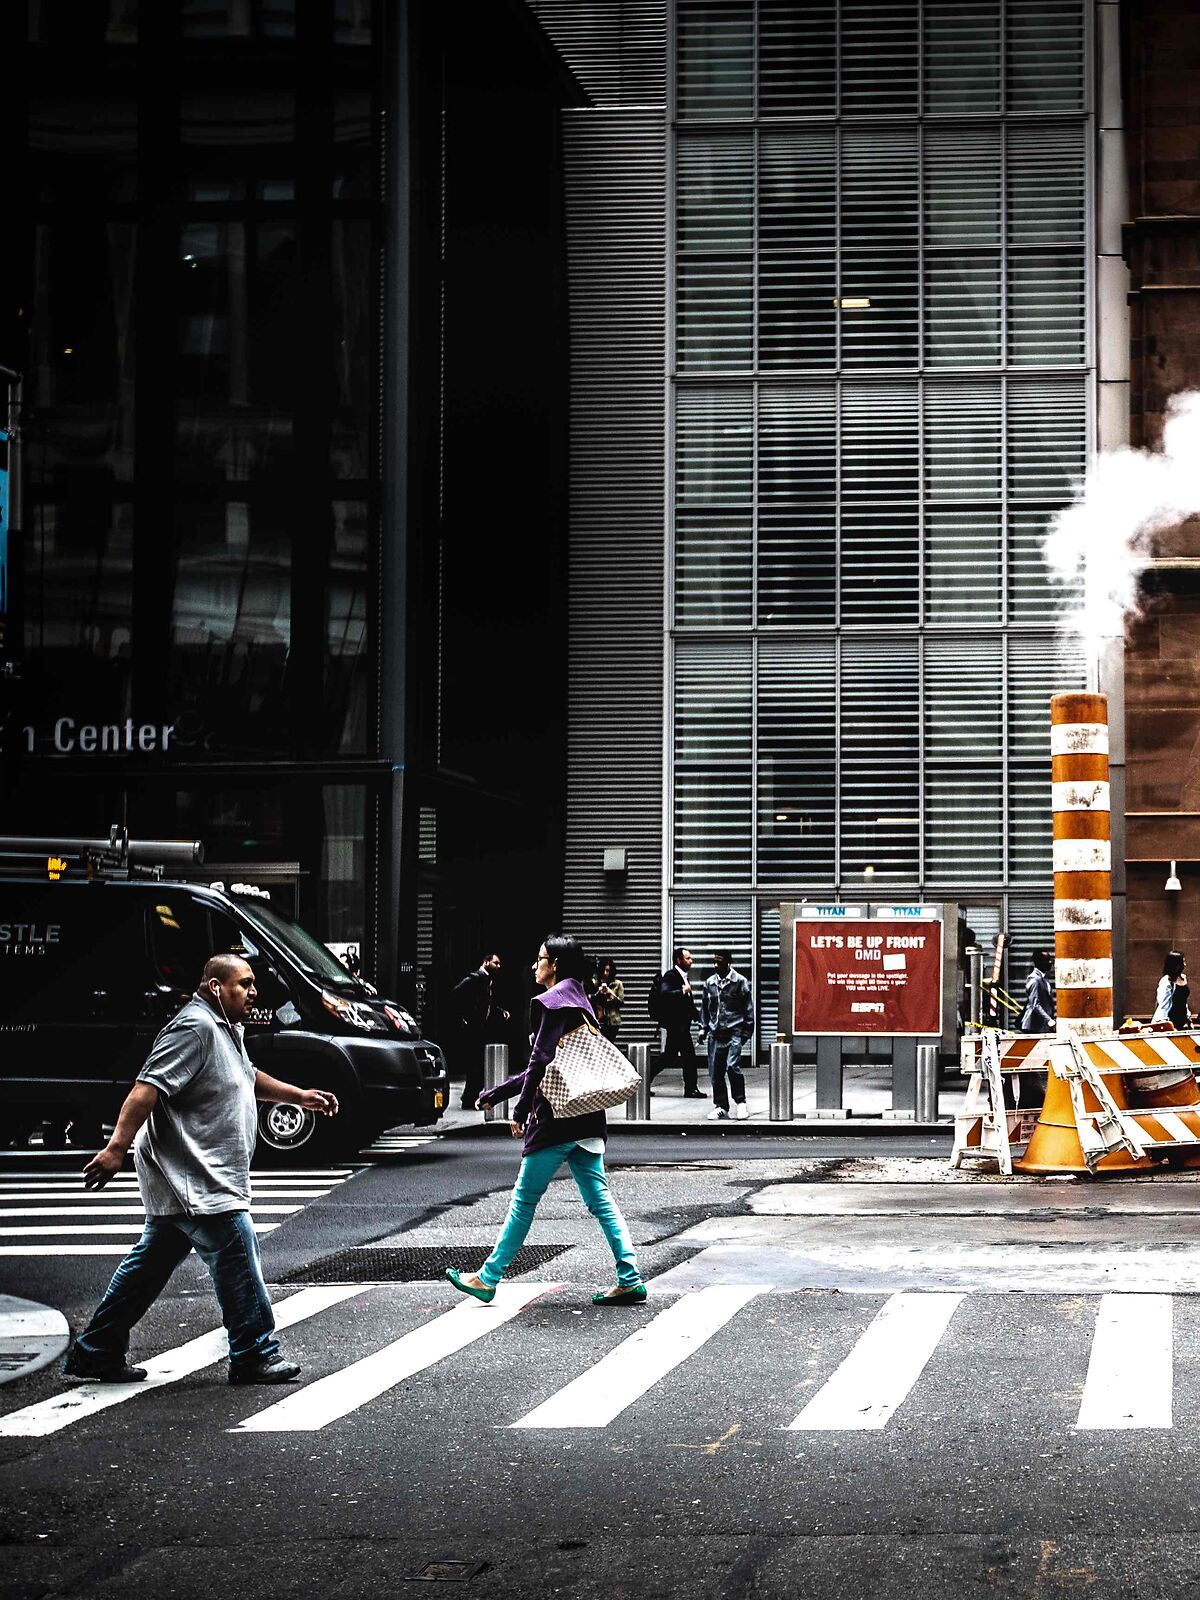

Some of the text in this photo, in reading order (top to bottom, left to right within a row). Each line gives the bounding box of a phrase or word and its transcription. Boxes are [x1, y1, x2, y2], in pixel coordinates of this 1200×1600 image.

[54, 716, 174, 752] Center
[816, 907, 846, 916] TITAN
[892, 907, 922, 916] TITAN
[810, 936, 926, 948] LET'S BE UP FRONT
[855, 949, 881, 961] OMD
[851, 1003, 885, 1013] ESPN
